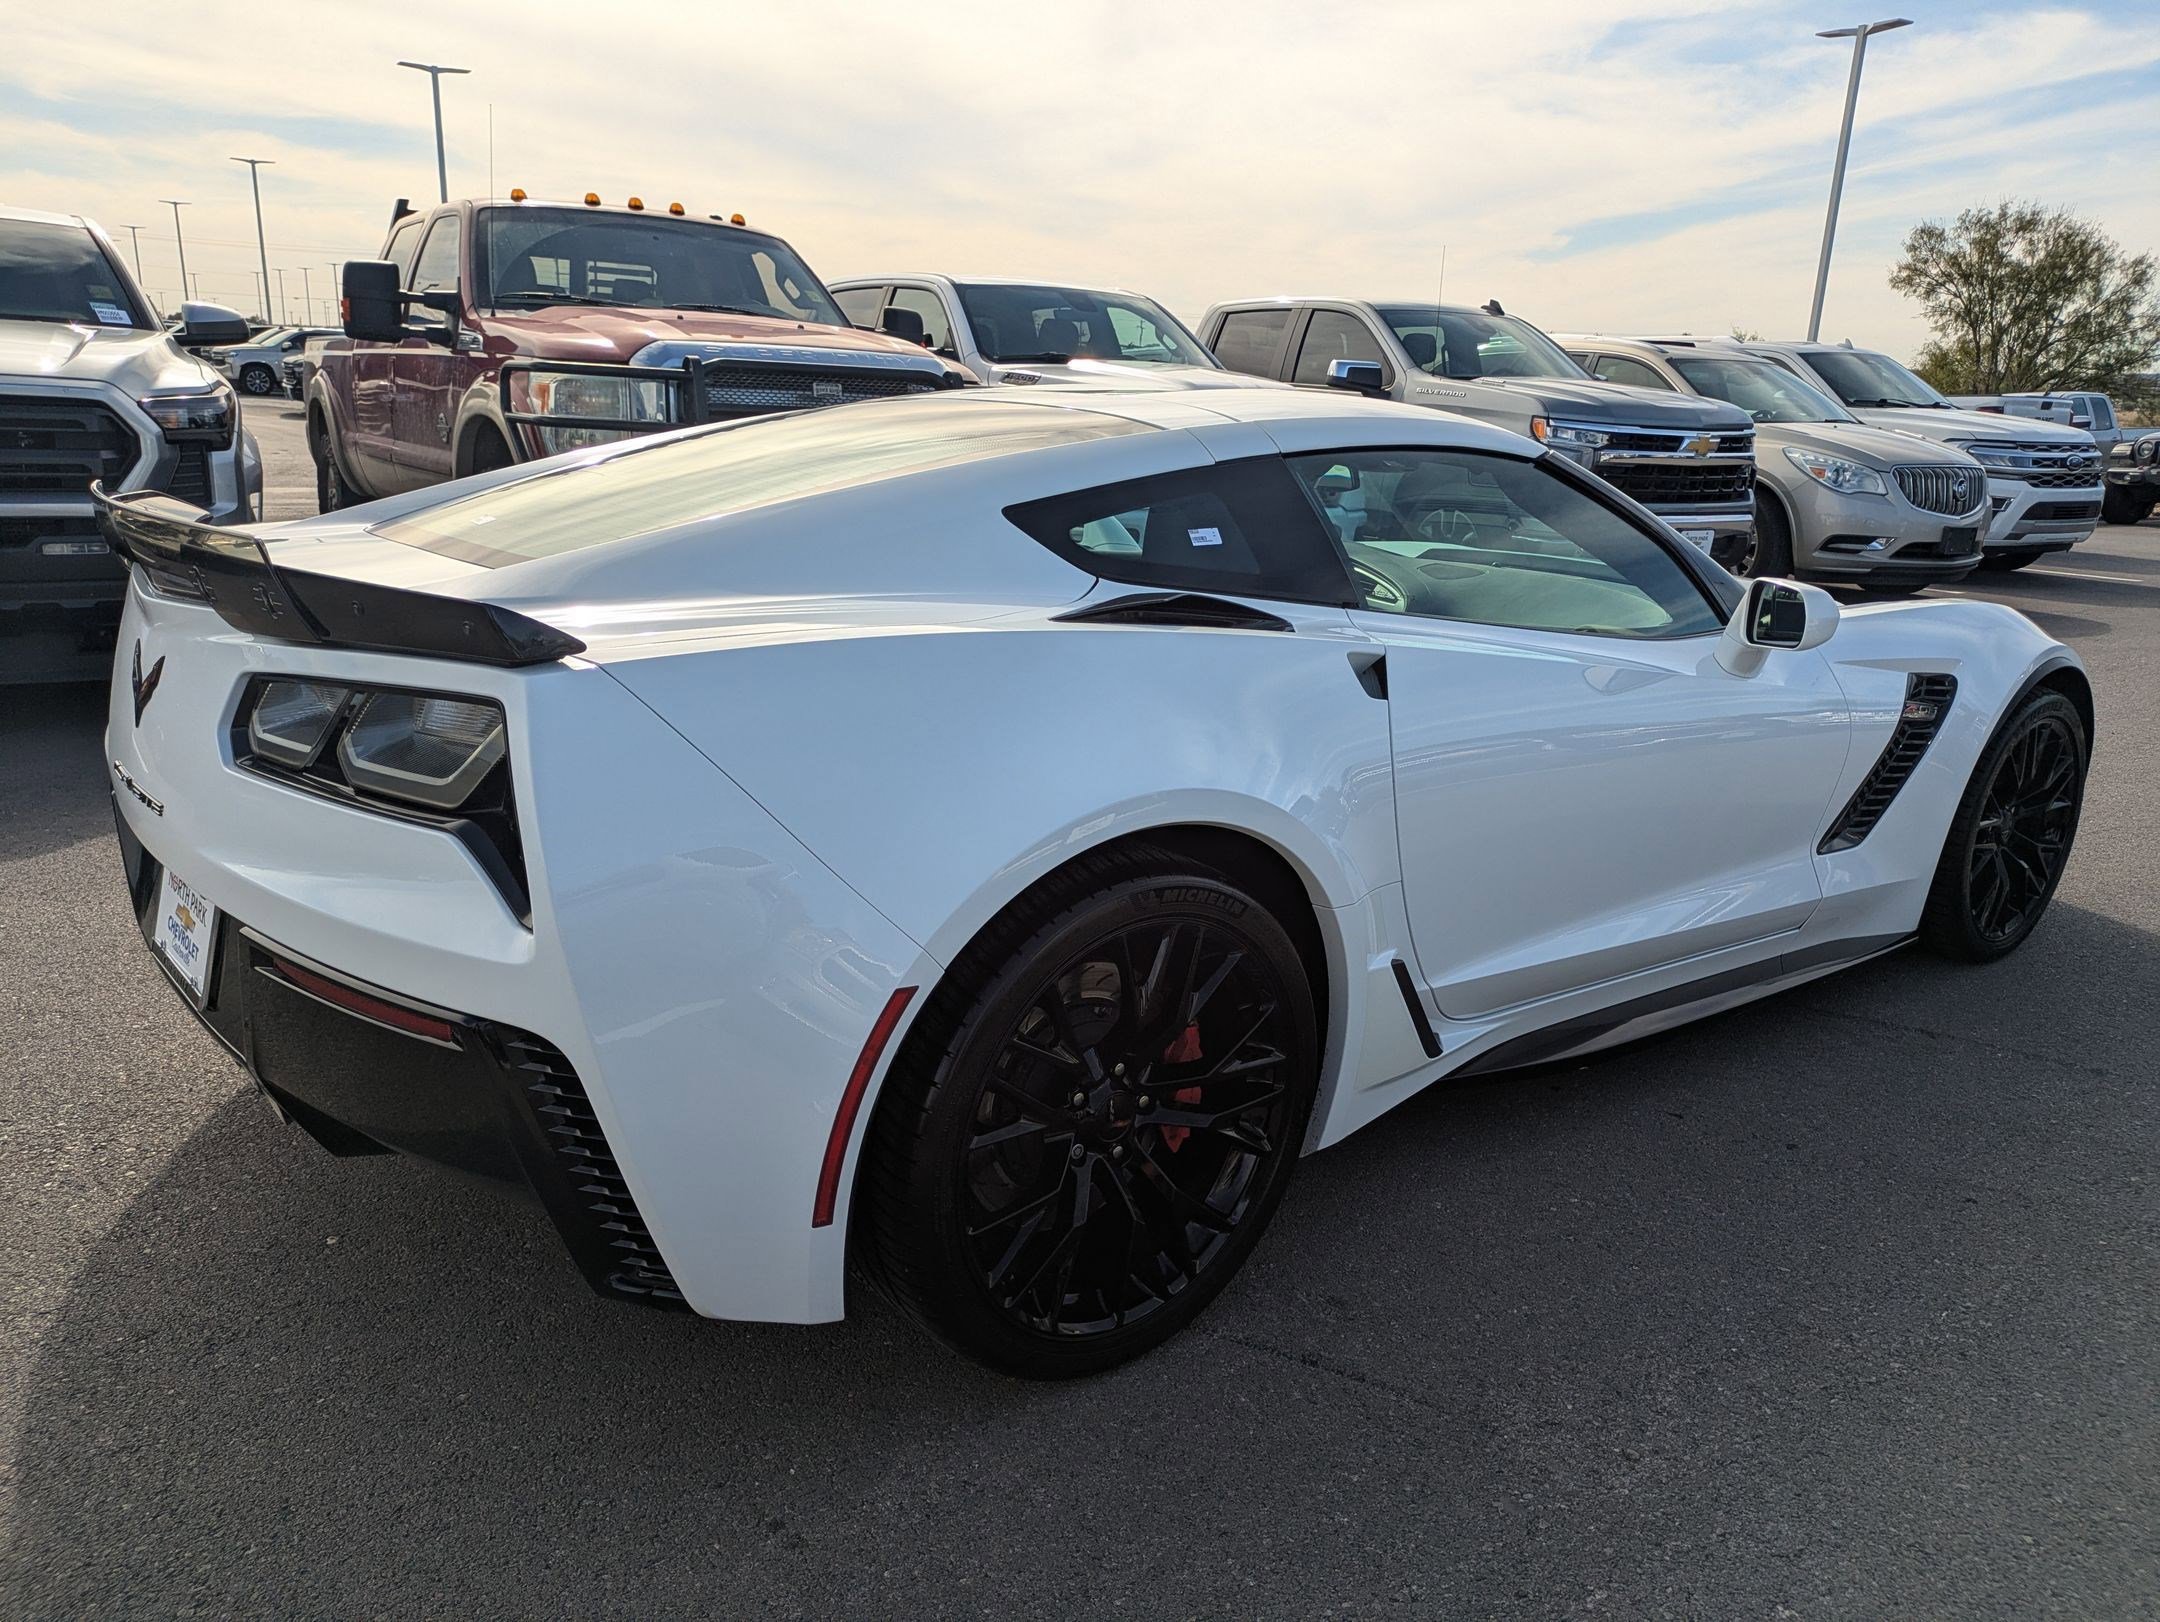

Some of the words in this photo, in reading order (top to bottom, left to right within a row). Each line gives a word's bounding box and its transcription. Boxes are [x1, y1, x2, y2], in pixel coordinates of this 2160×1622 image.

[1416, 387, 1467, 398] SILVERADO
[168, 871, 190, 906] NORTH
[190, 896, 208, 928] PARK
[1162, 888, 1246, 915] MICHELIN
[167, 915, 199, 962] CHEVROLET
